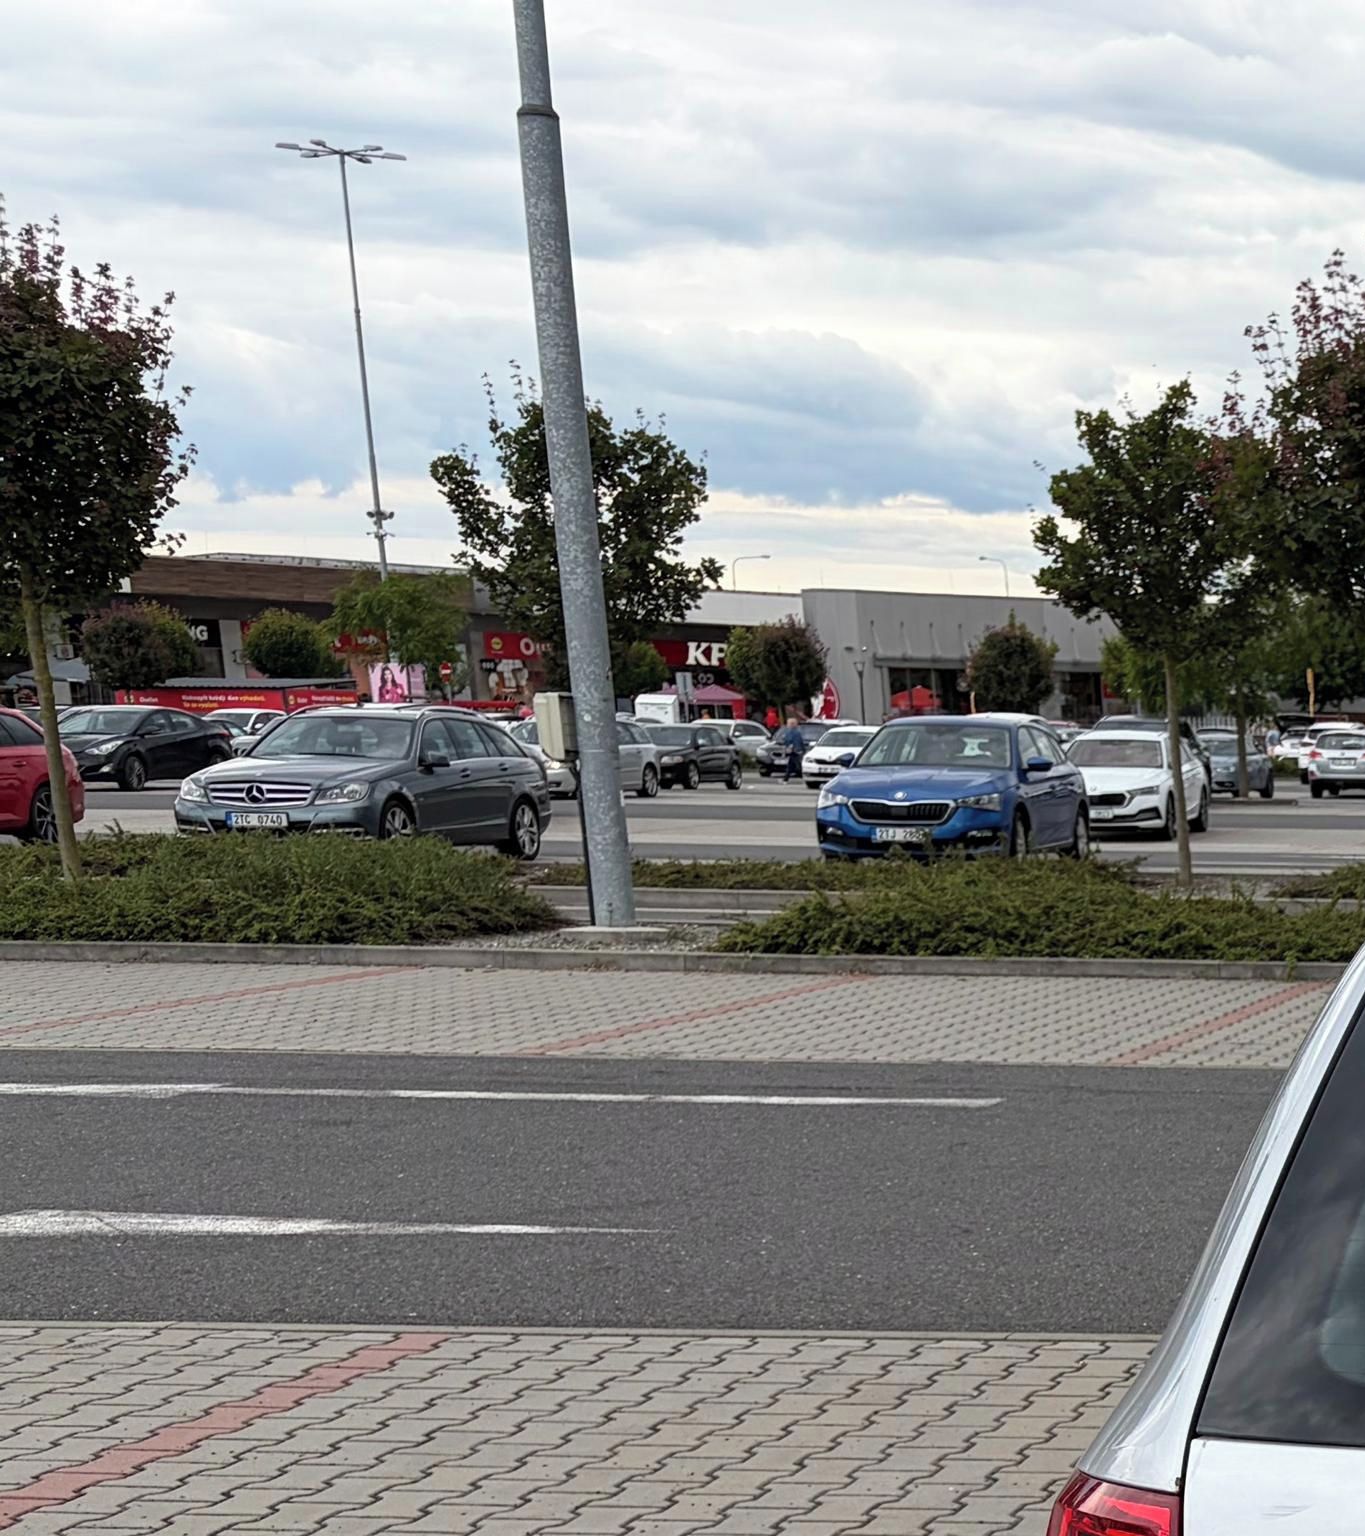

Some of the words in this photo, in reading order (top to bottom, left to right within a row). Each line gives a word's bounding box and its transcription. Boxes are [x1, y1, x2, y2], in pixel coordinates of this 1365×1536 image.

[684, 641, 728, 667] KF
[234, 814, 251, 825] 2TC
[257, 814, 283, 826] 0740
